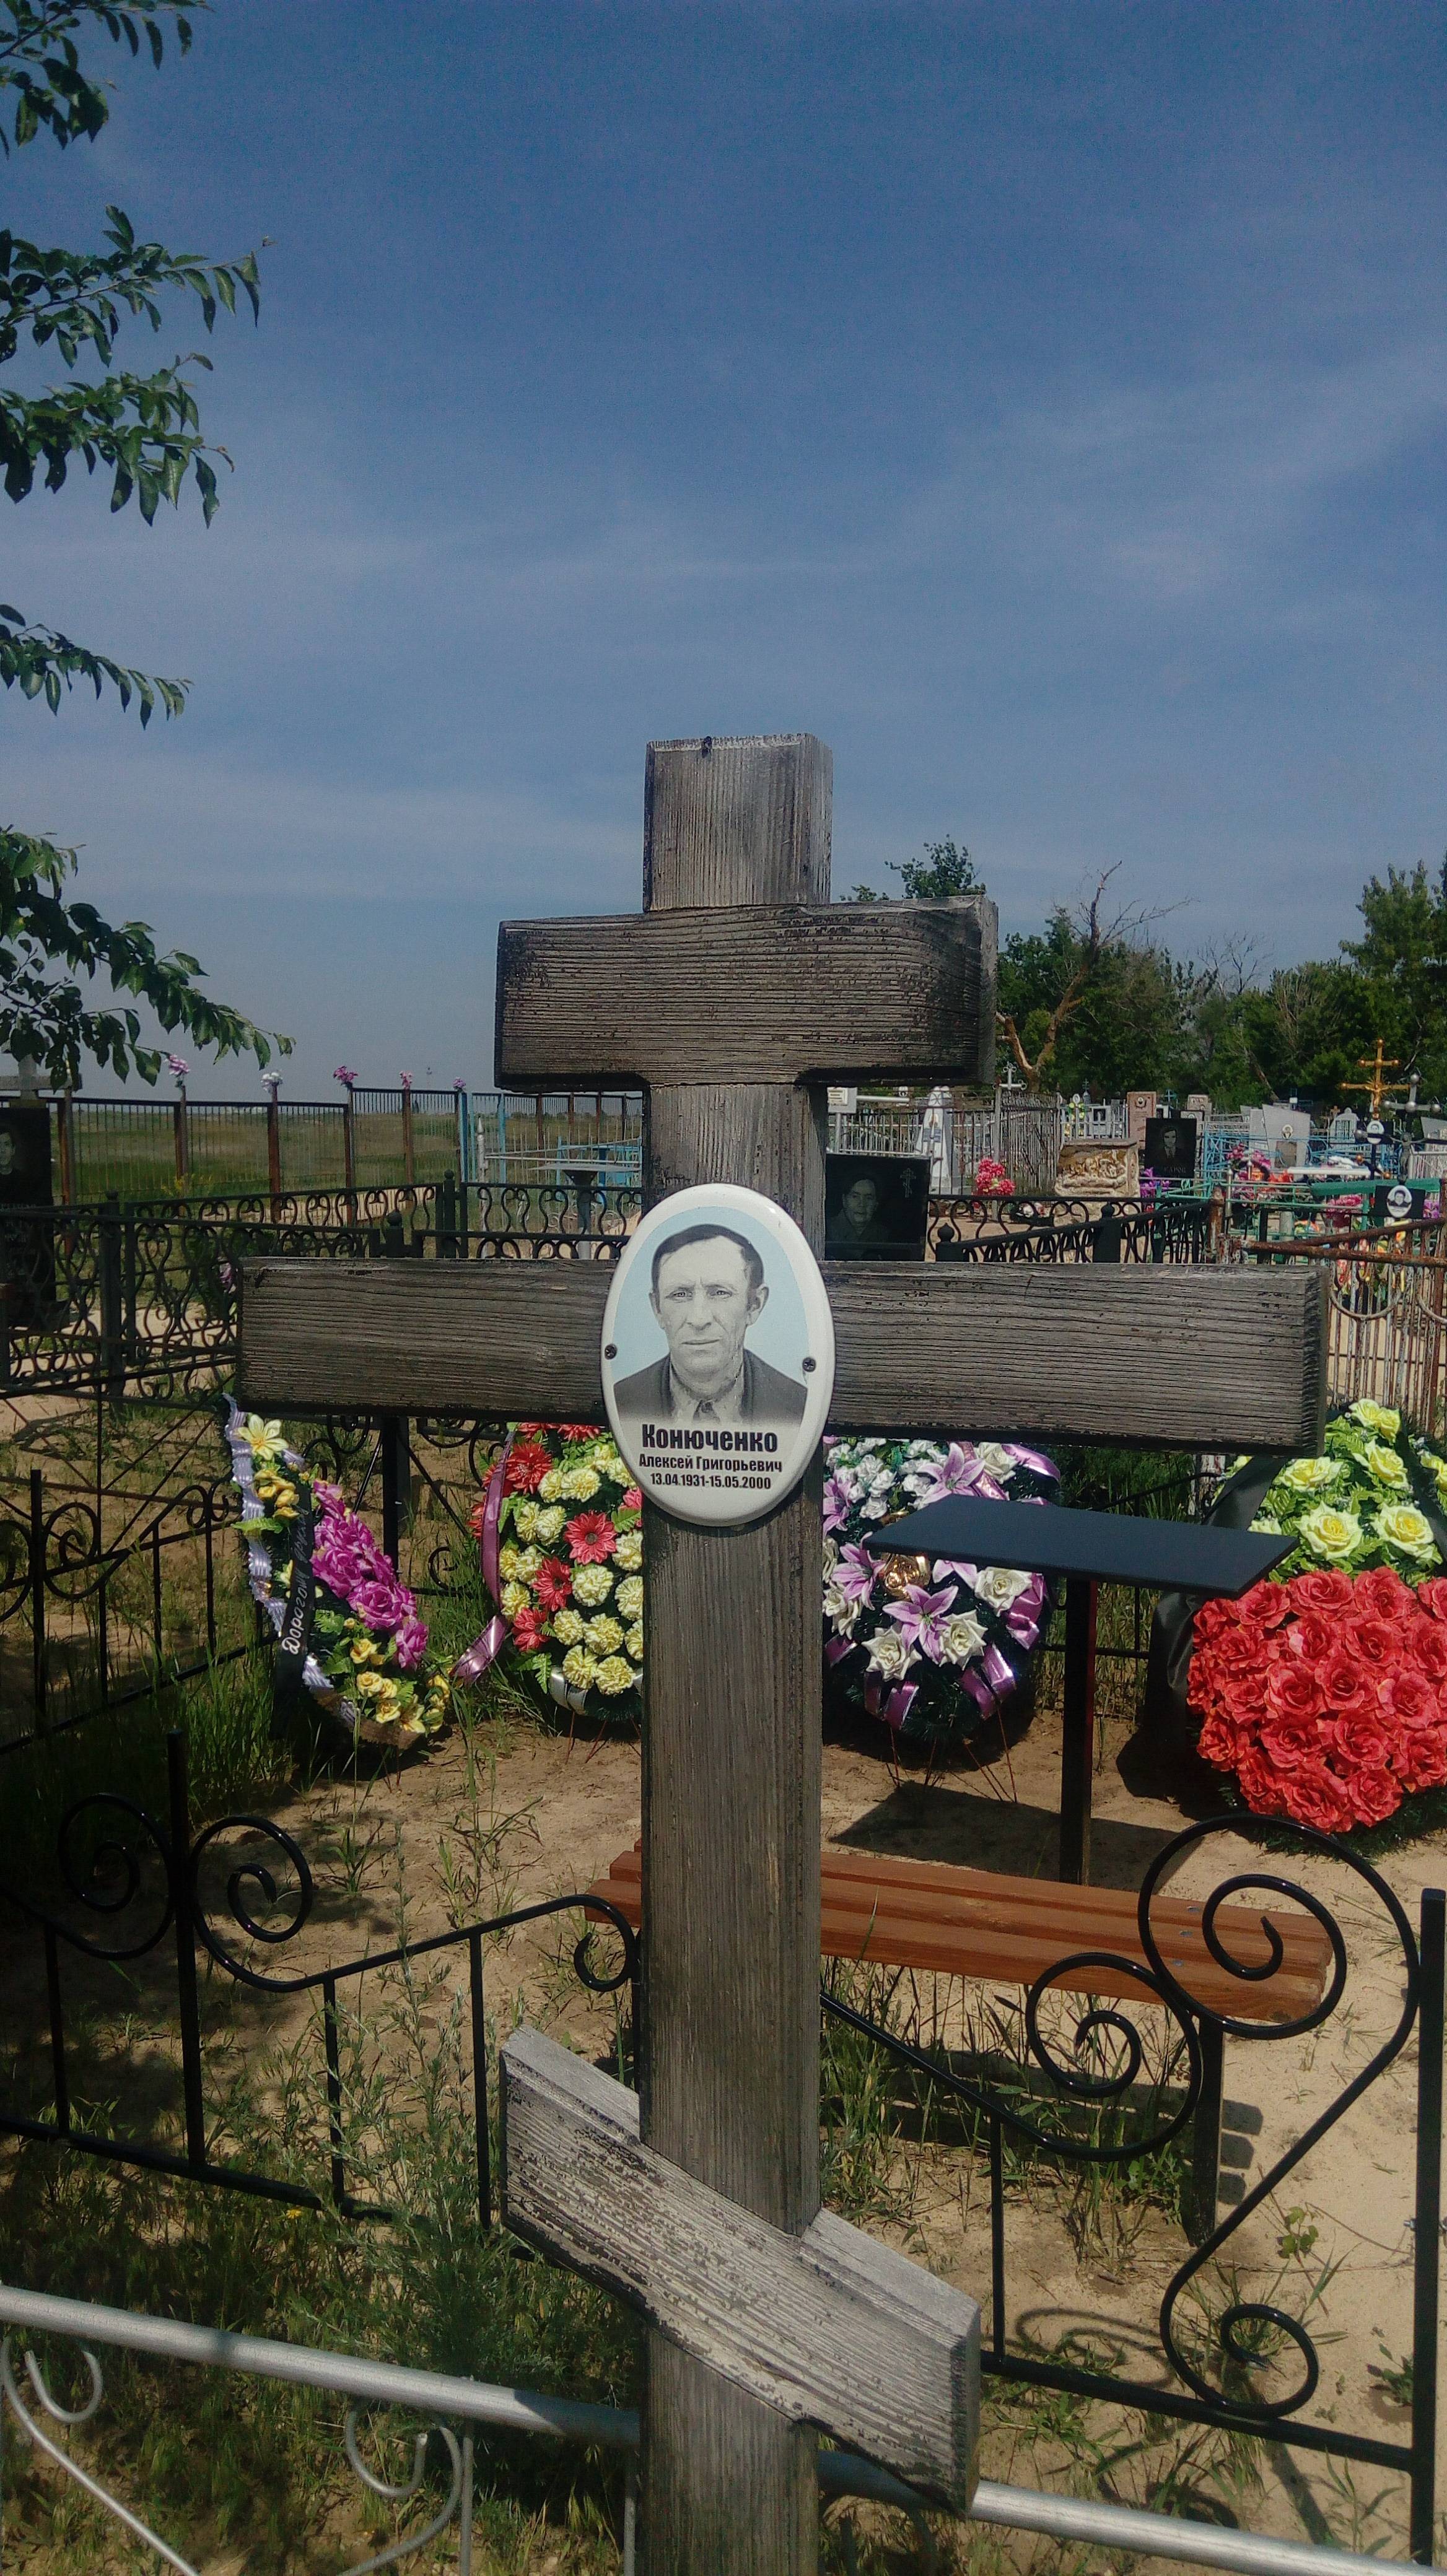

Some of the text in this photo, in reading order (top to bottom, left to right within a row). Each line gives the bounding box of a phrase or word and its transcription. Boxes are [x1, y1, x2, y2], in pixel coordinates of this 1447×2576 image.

[642, 1424, 777, 1453] Конюченко
[639, 1453, 782, 1473] Алексей Григорьевич
[650, 1473, 771, 1489] 13.04.1931-15.05.2000
[281, 1567, 310, 1655] Дорогому
